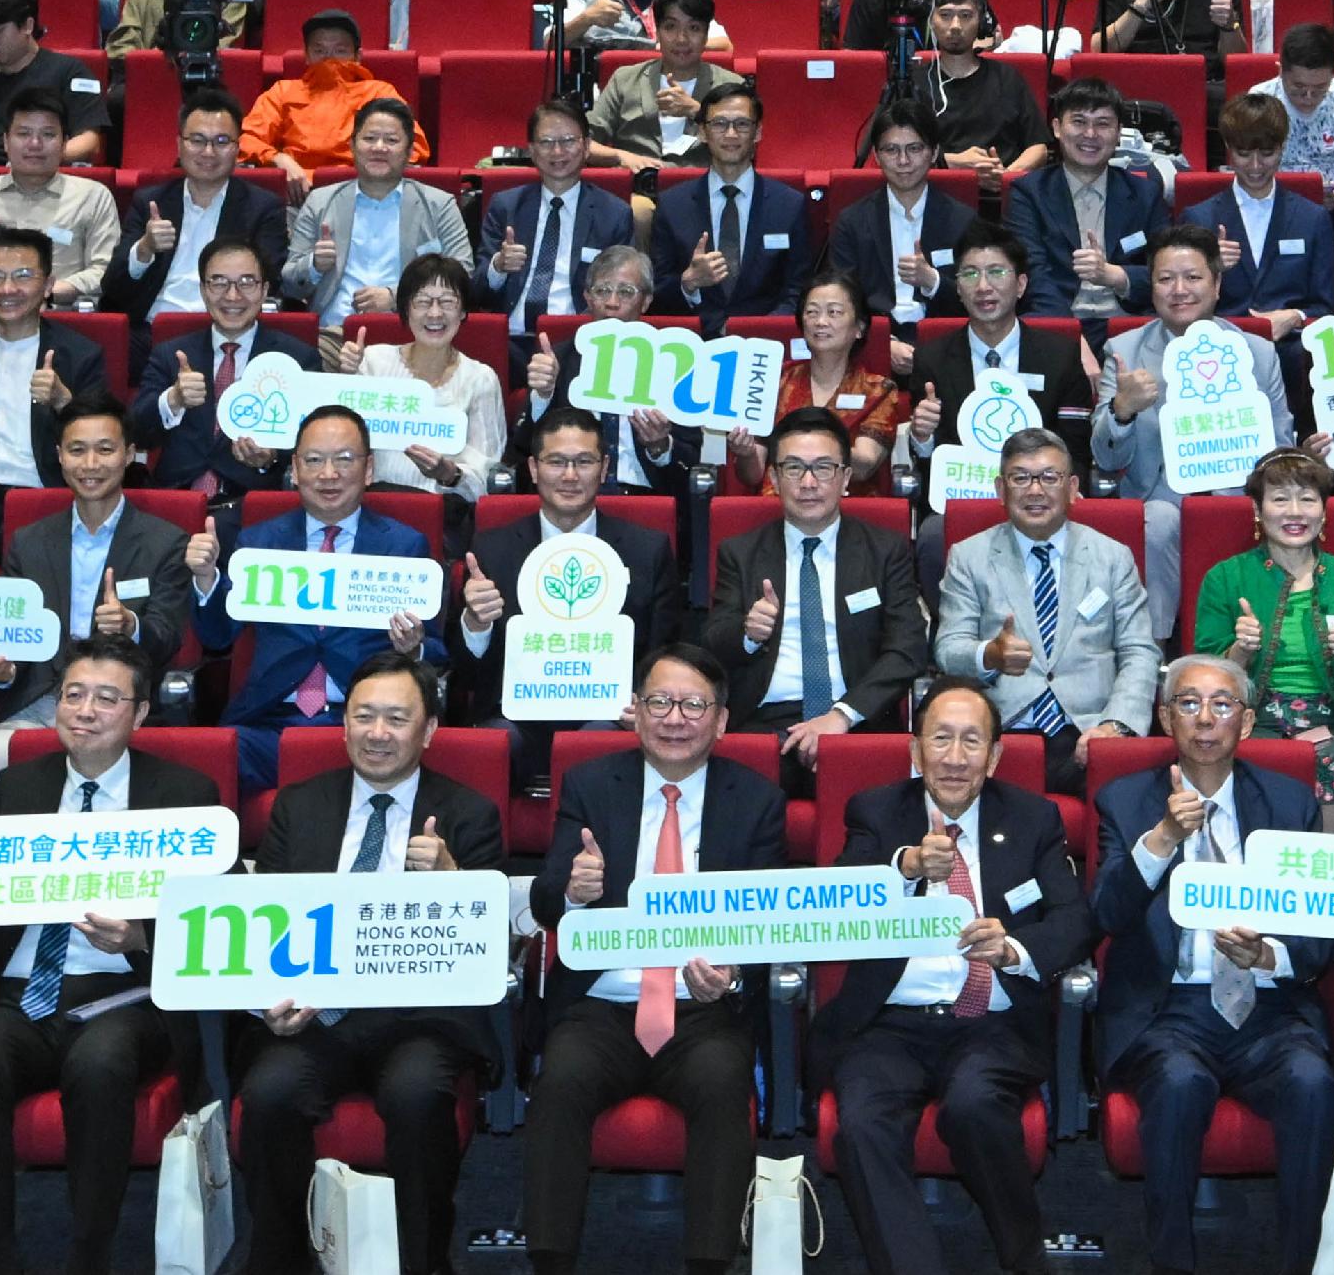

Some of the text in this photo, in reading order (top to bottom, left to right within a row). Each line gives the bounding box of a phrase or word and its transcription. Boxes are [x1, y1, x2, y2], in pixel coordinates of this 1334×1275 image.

[583, 333, 738, 417] mu
[744, 353, 769, 421] HKMU
[337, 389, 420, 414] 低碳未來
[404, 421, 455, 438] FUTURE
[1174, 406, 1259, 436] 連繫社區
[1178, 434, 1259, 457] COMMUNITY
[241, 564, 337, 610] mu
[351, 570, 429, 583] 香港都會大學
[349, 584, 410, 594] HONG KONG
[347, 604, 407, 613] UNIVERSITY
[348, 594, 427, 606] METROPOLITAN
[523, 632, 614, 654] 綠色環境
[543, 661, 592, 676] GREEN
[514, 683, 619, 699] ENVIRONMENT
[645, 883, 888, 916] HKMU NEW CAMPUS
[1184, 883, 1297, 914] BUILDING
[358, 901, 488, 921] 香港都會大學
[176, 903, 339, 978] mu
[357, 926, 458, 939] HONG KONG
[571, 916, 962, 951] A HUB FOR COMMUNITY HEALTH AND WELLNESS
[356, 942, 486, 957] METROPOLITAN
[355, 961, 455, 975] UNIVERSITY
